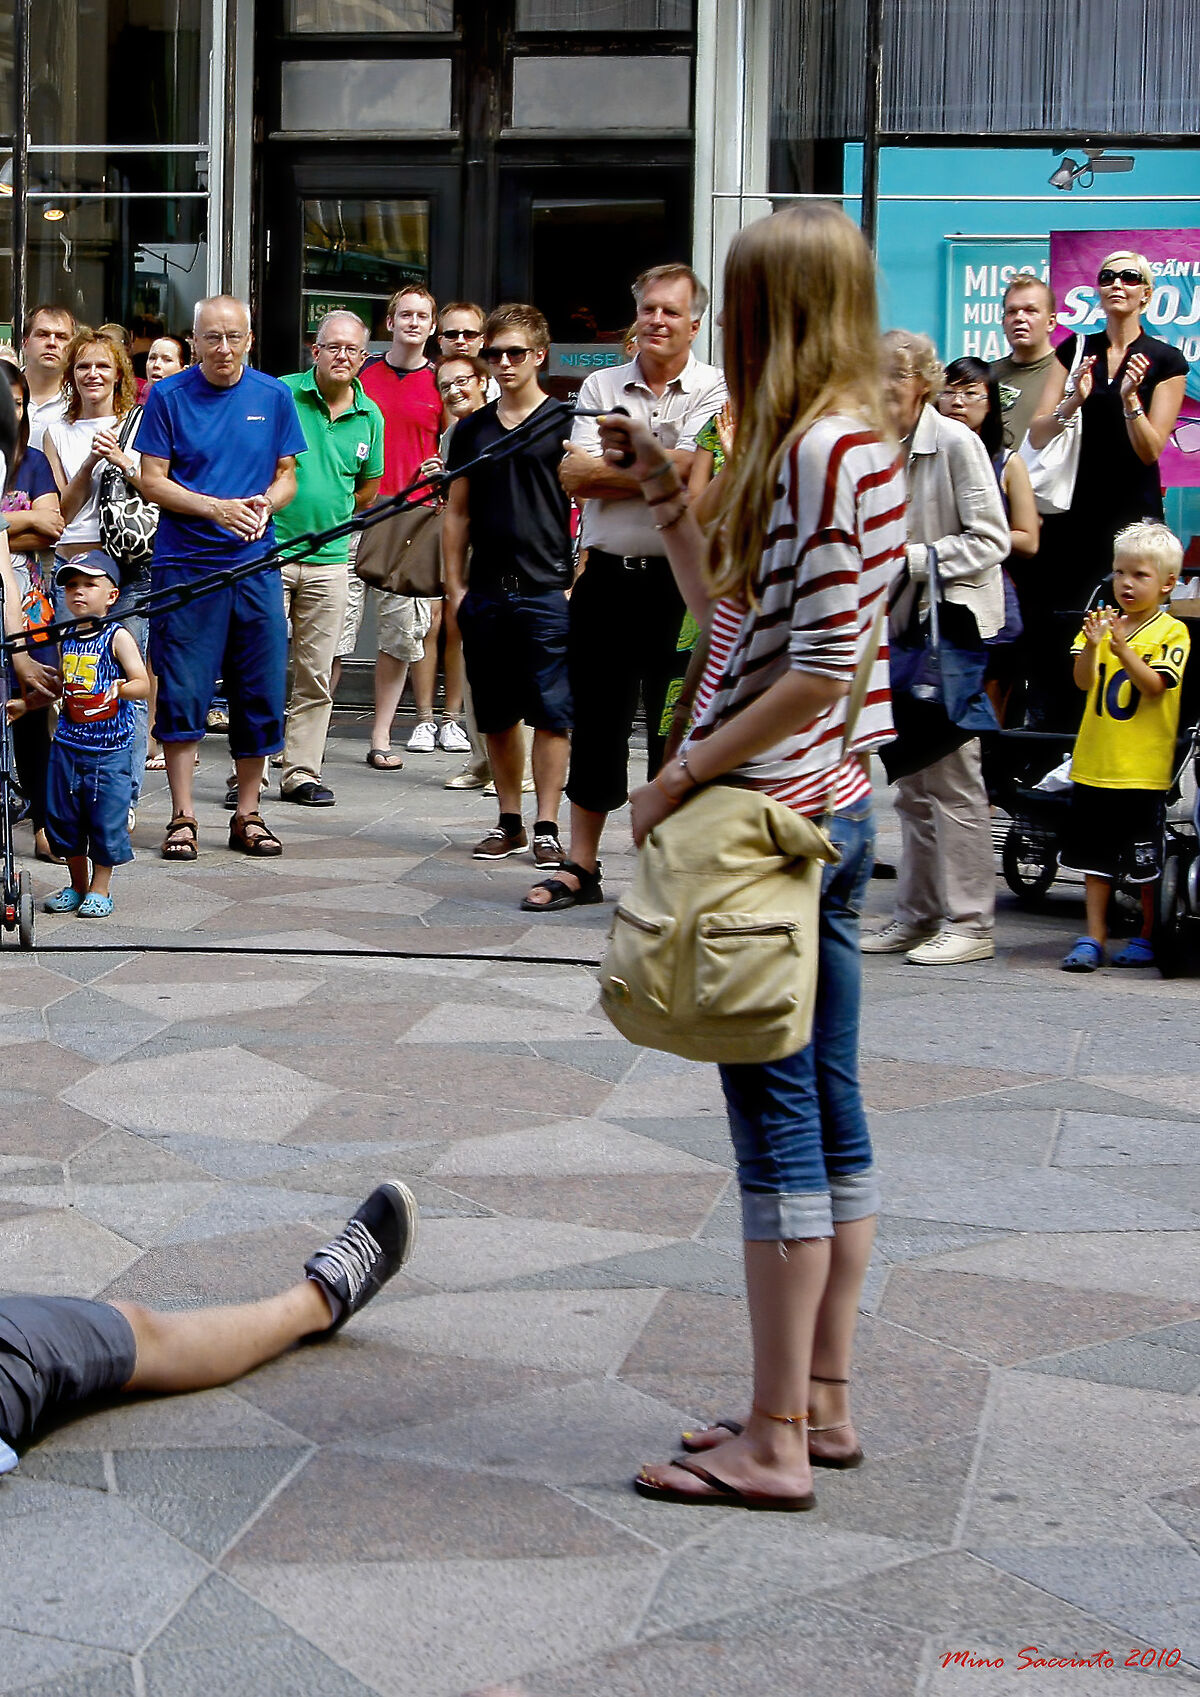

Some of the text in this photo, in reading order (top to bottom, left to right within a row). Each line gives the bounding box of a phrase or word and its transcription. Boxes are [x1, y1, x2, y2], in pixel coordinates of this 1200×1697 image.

[964, 259, 1050, 297] MIS
[1149, 258, 1189, 277] SÄN
[1162, 644, 1184, 667] 10
[1096, 663, 1142, 720] 10
